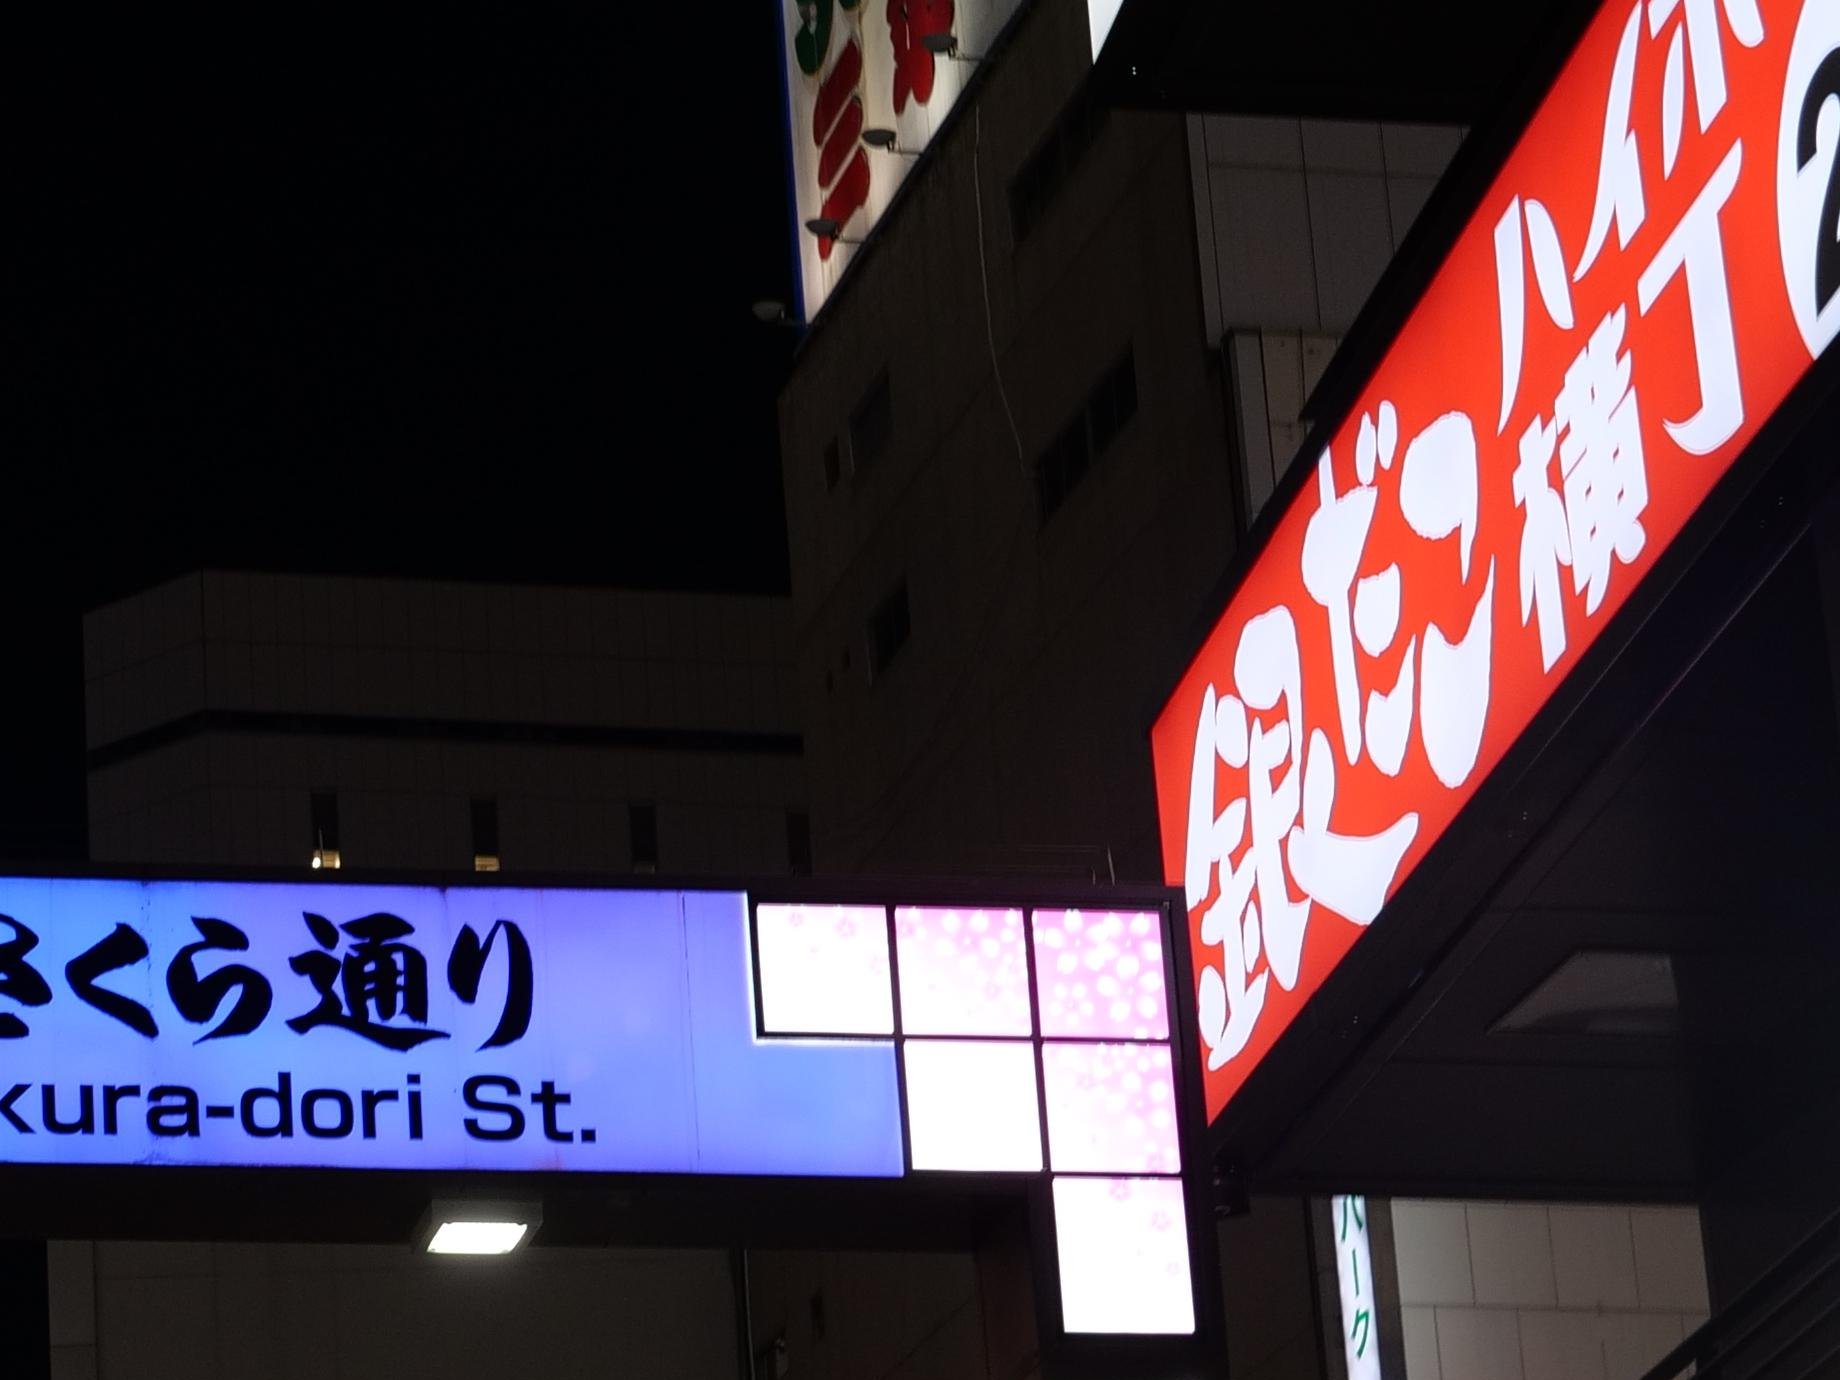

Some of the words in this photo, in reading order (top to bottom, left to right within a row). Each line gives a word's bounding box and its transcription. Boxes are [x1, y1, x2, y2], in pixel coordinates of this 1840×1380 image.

[1512, 138, 1743, 674] 横丁
[1185, 400, 1495, 1070] 銀だこ
[463, 1073, 597, 1144] St.
